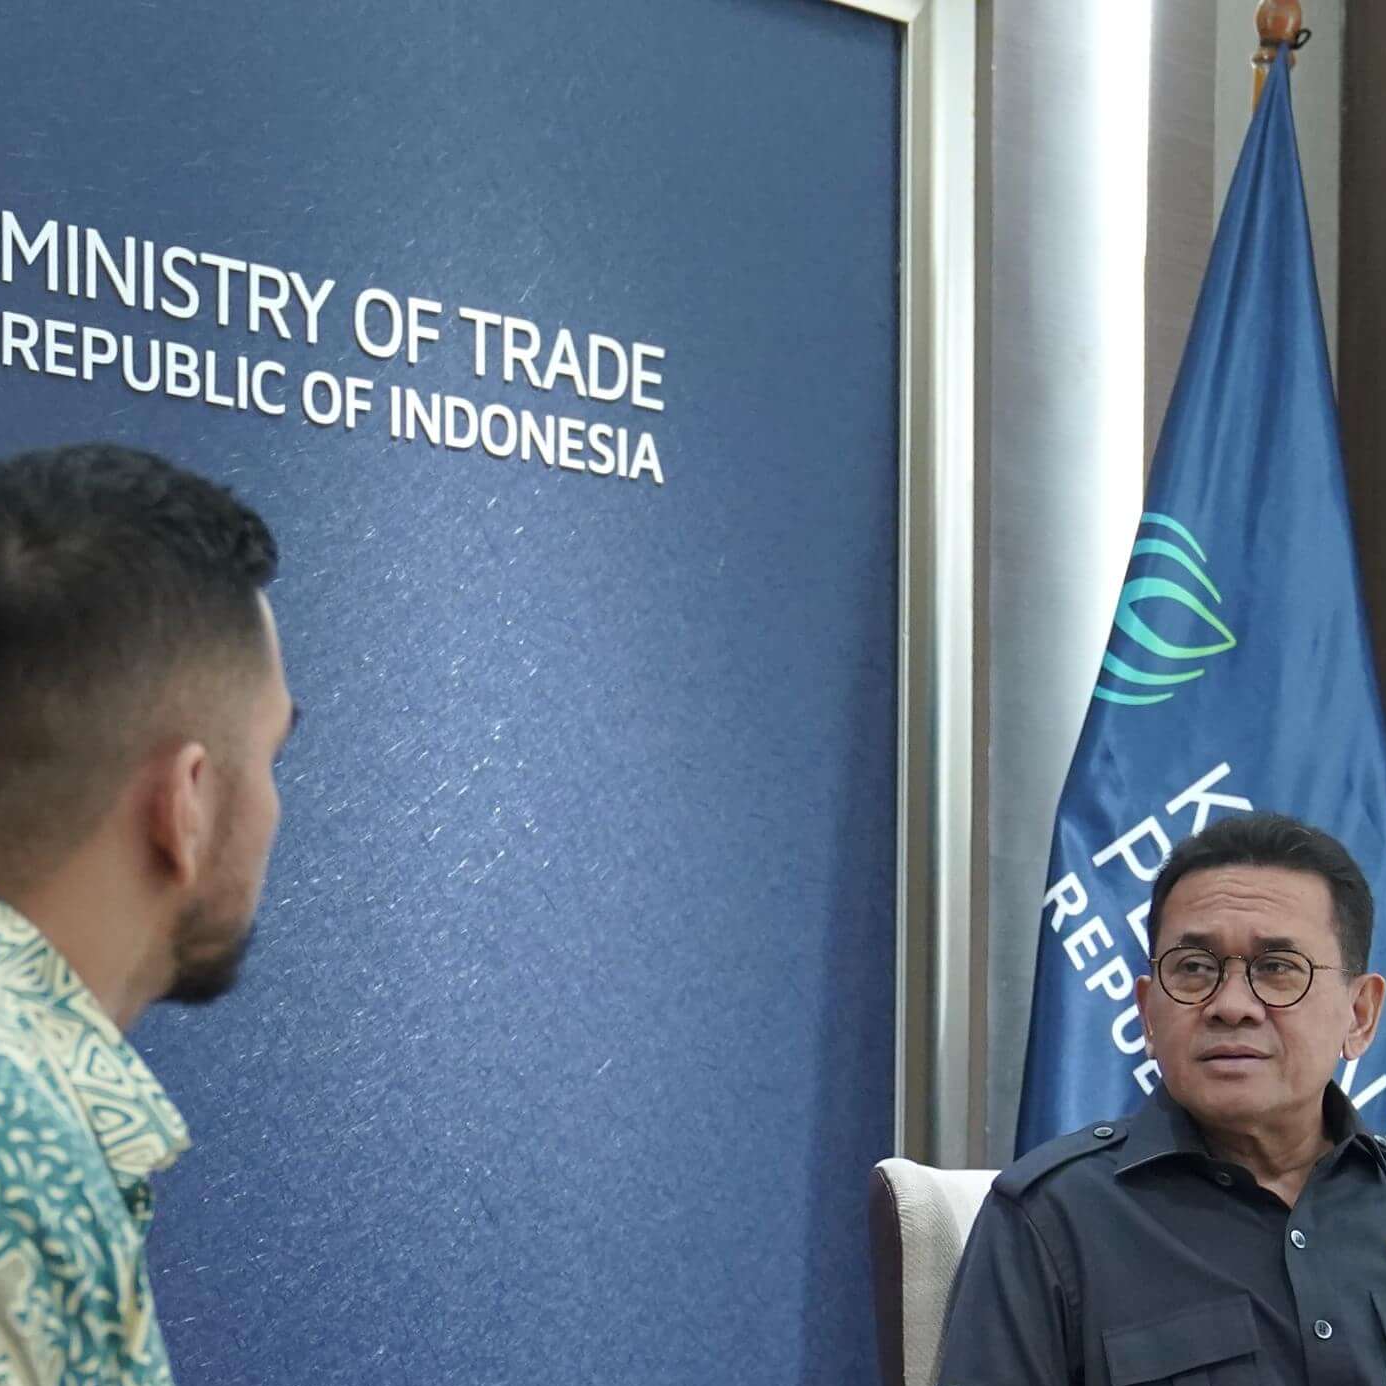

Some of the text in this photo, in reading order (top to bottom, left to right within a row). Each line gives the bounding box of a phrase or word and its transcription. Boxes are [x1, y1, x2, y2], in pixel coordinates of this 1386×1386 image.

[1, 210, 665, 411] MINISTRY OF TRADE
[1, 311, 664, 484] REPUBLIC OF INDONESIA
